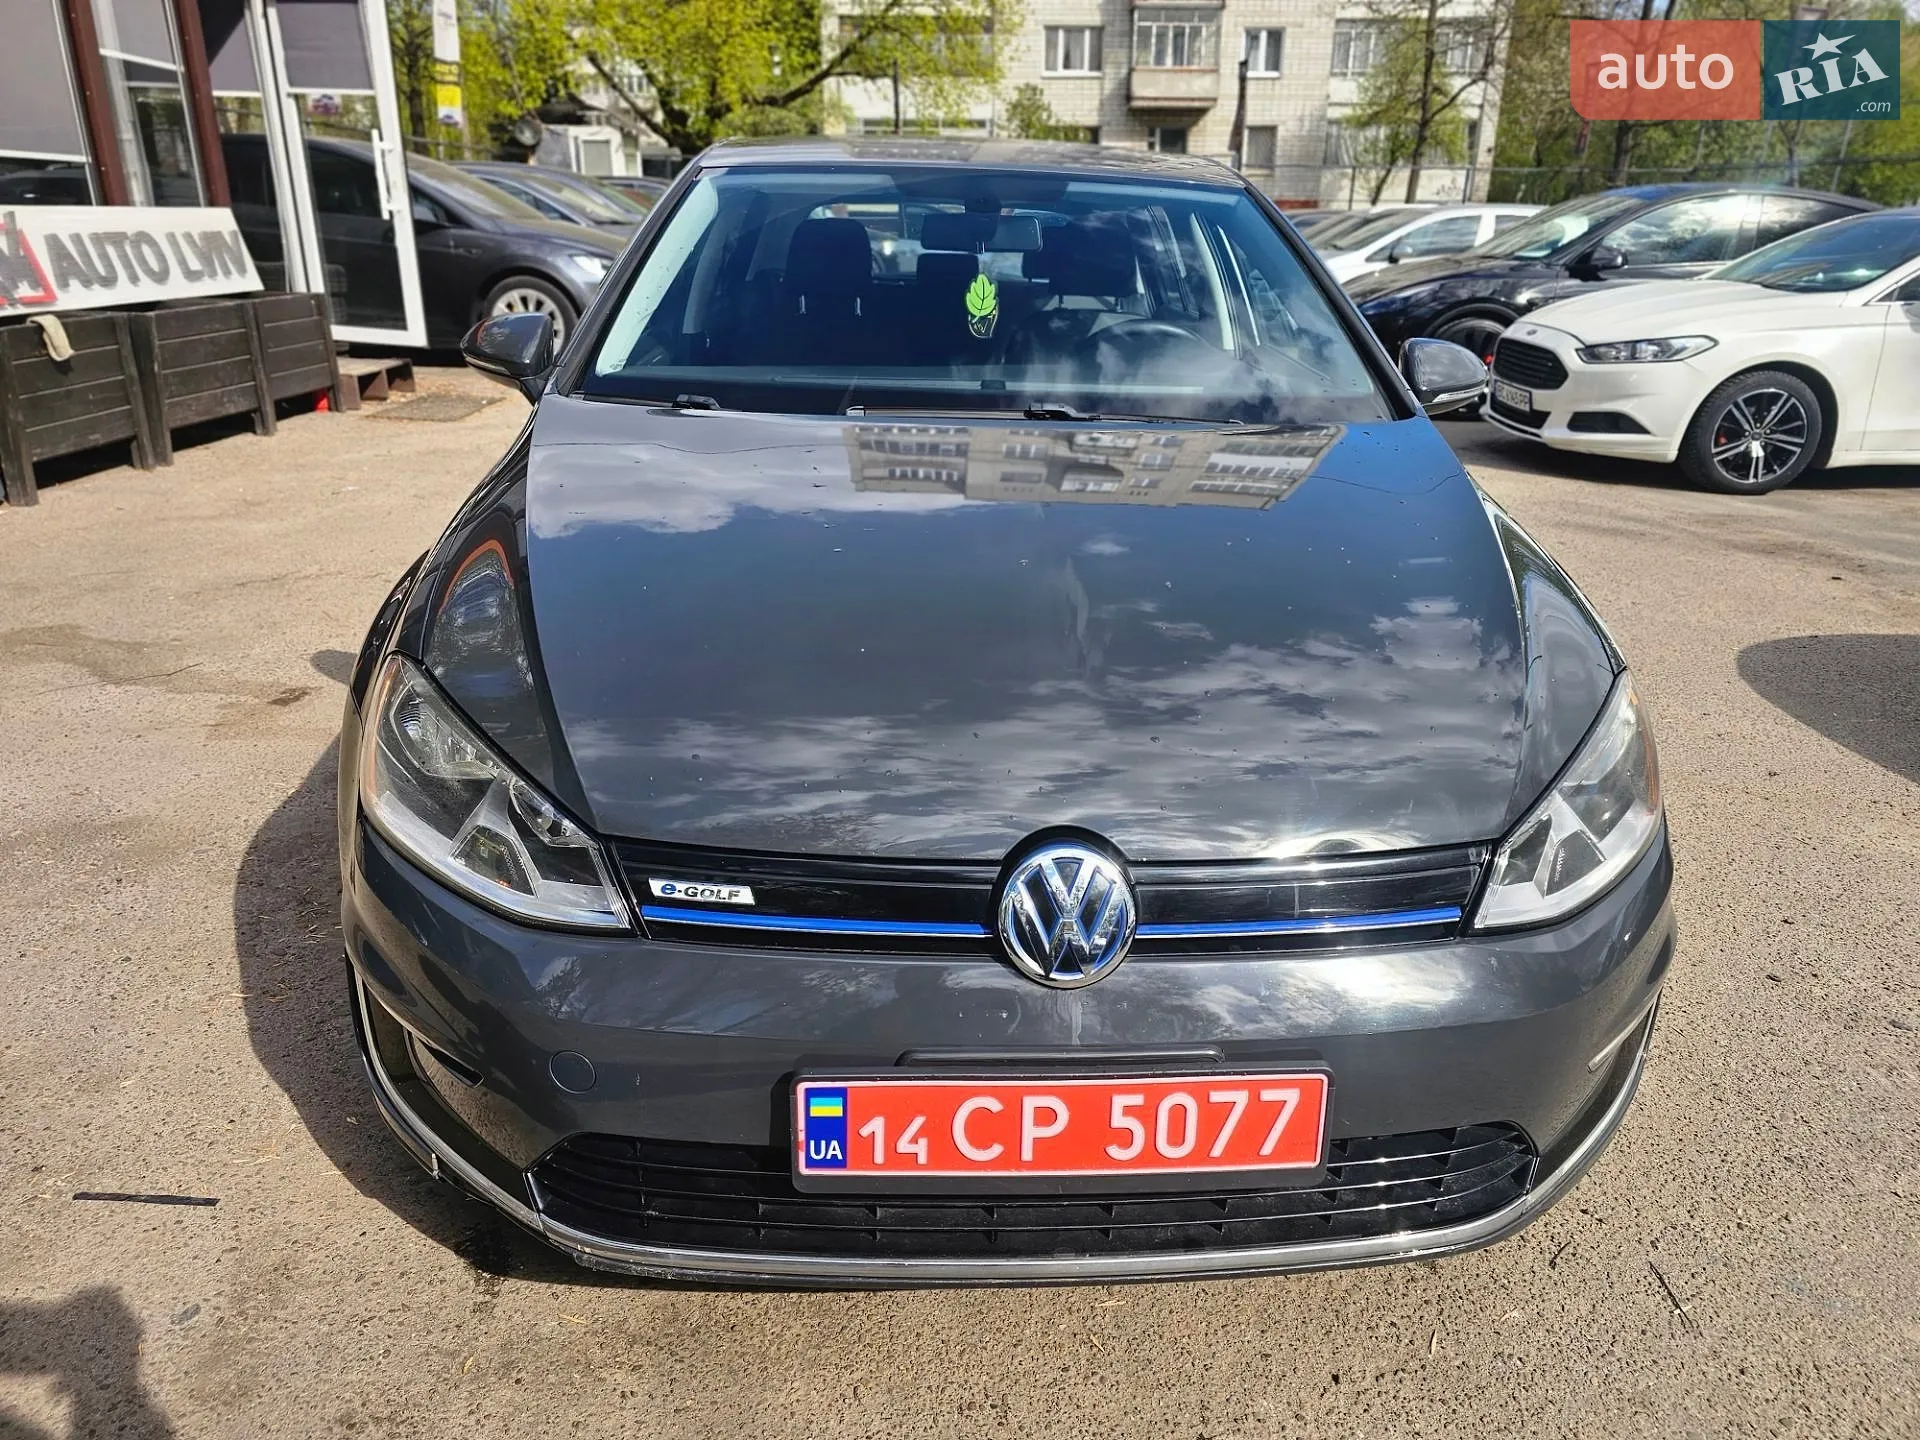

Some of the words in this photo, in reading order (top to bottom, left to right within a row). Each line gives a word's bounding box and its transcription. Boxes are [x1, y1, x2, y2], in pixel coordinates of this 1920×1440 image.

[43, 230, 170, 293] AUTO
[660, 883, 741, 901] e-GOLF
[857, 1115, 929, 1165] 14
[951, 1095, 1070, 1163] CP
[1104, 1088, 1301, 1161] 5077
[809, 1139, 843, 1161] UA
